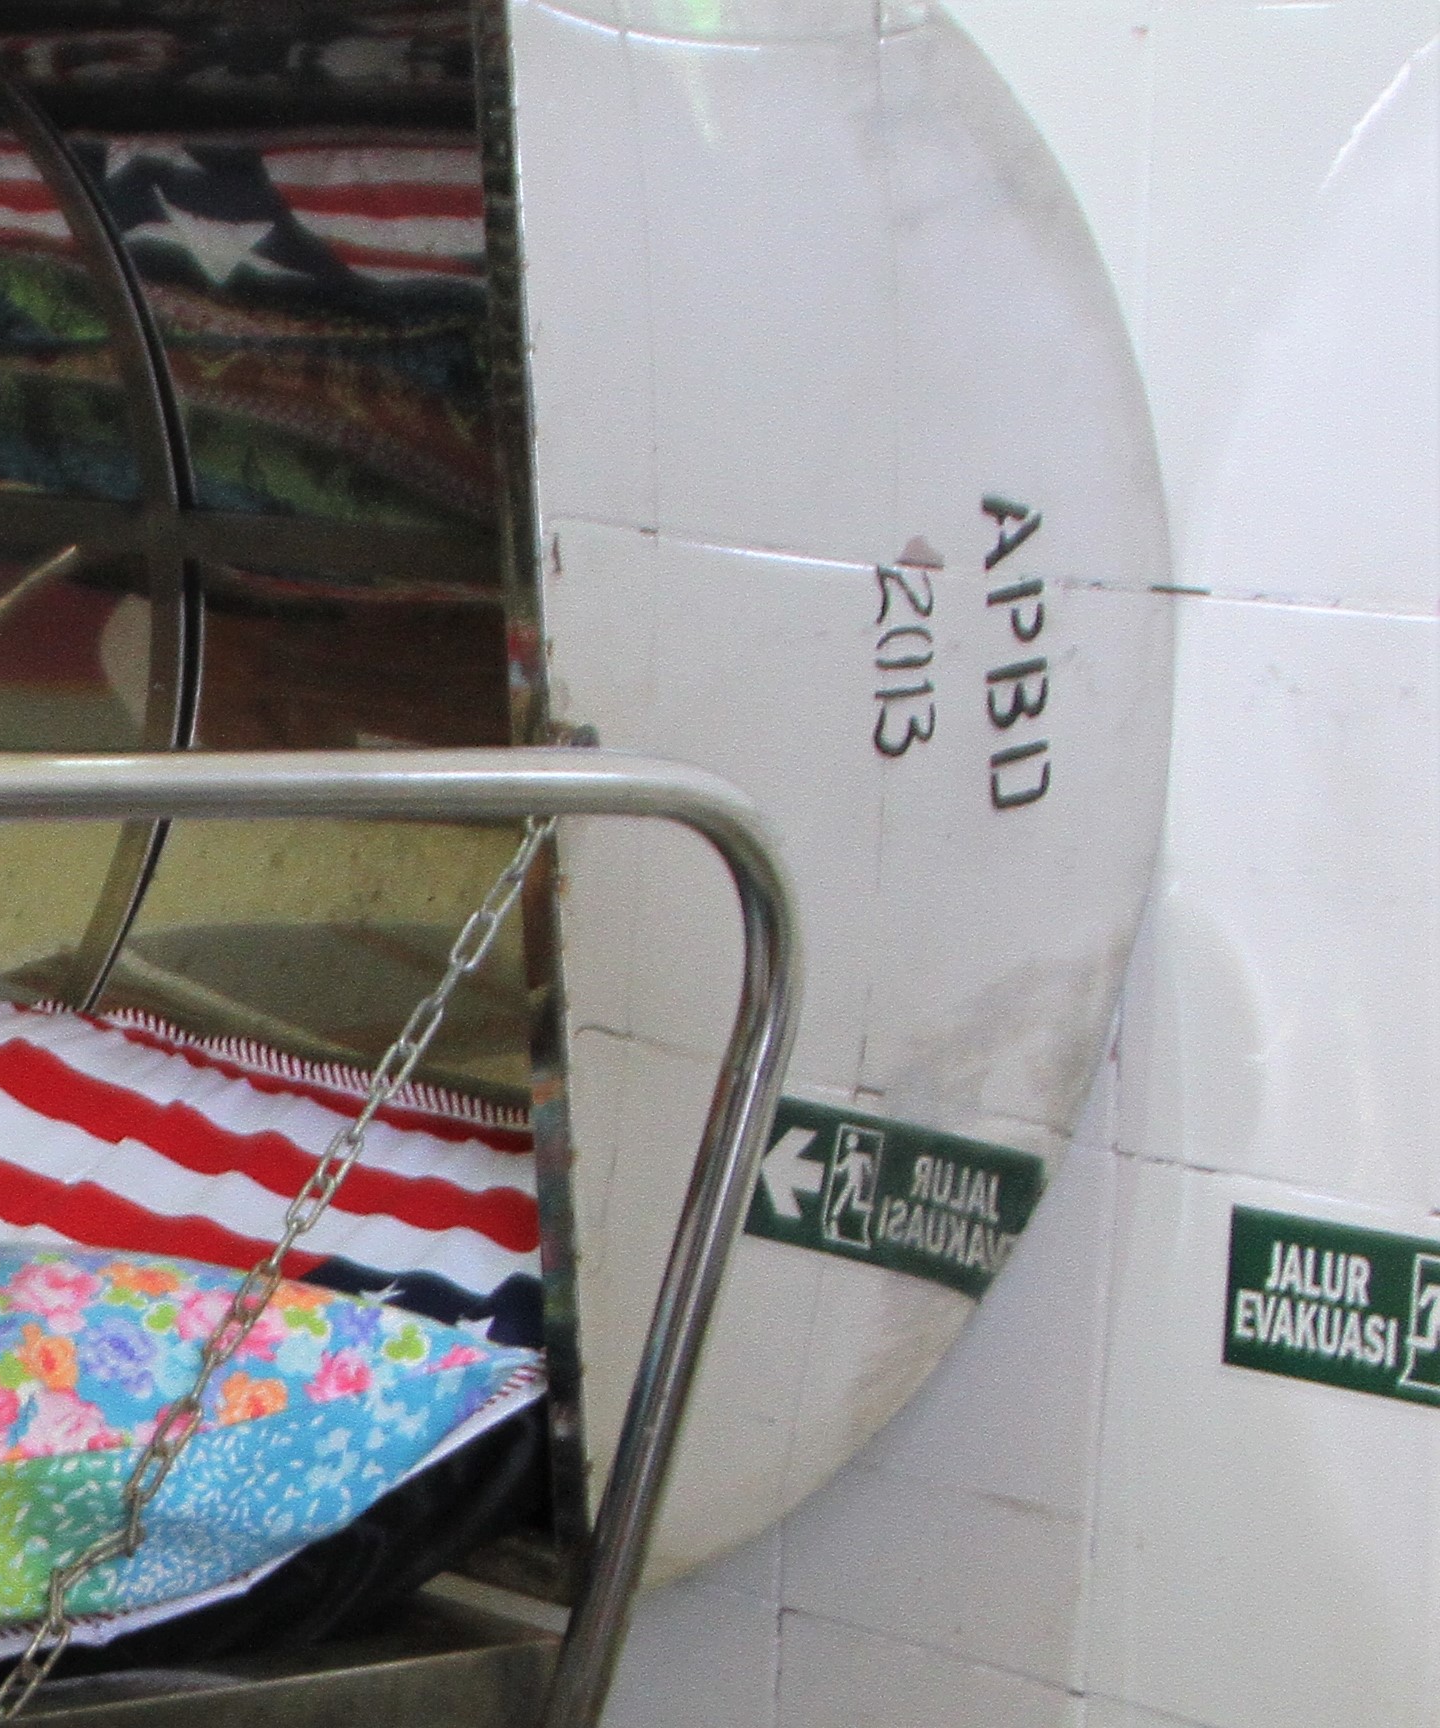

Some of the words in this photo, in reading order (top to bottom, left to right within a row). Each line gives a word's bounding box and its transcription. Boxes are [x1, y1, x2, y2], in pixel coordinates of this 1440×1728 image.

[874, 565, 934, 757] 2013
[982, 494, 1051, 810] APBD
[1234, 1287, 1398, 1369] EVAKUASI
[1266, 1240, 1371, 1306] JALUR
